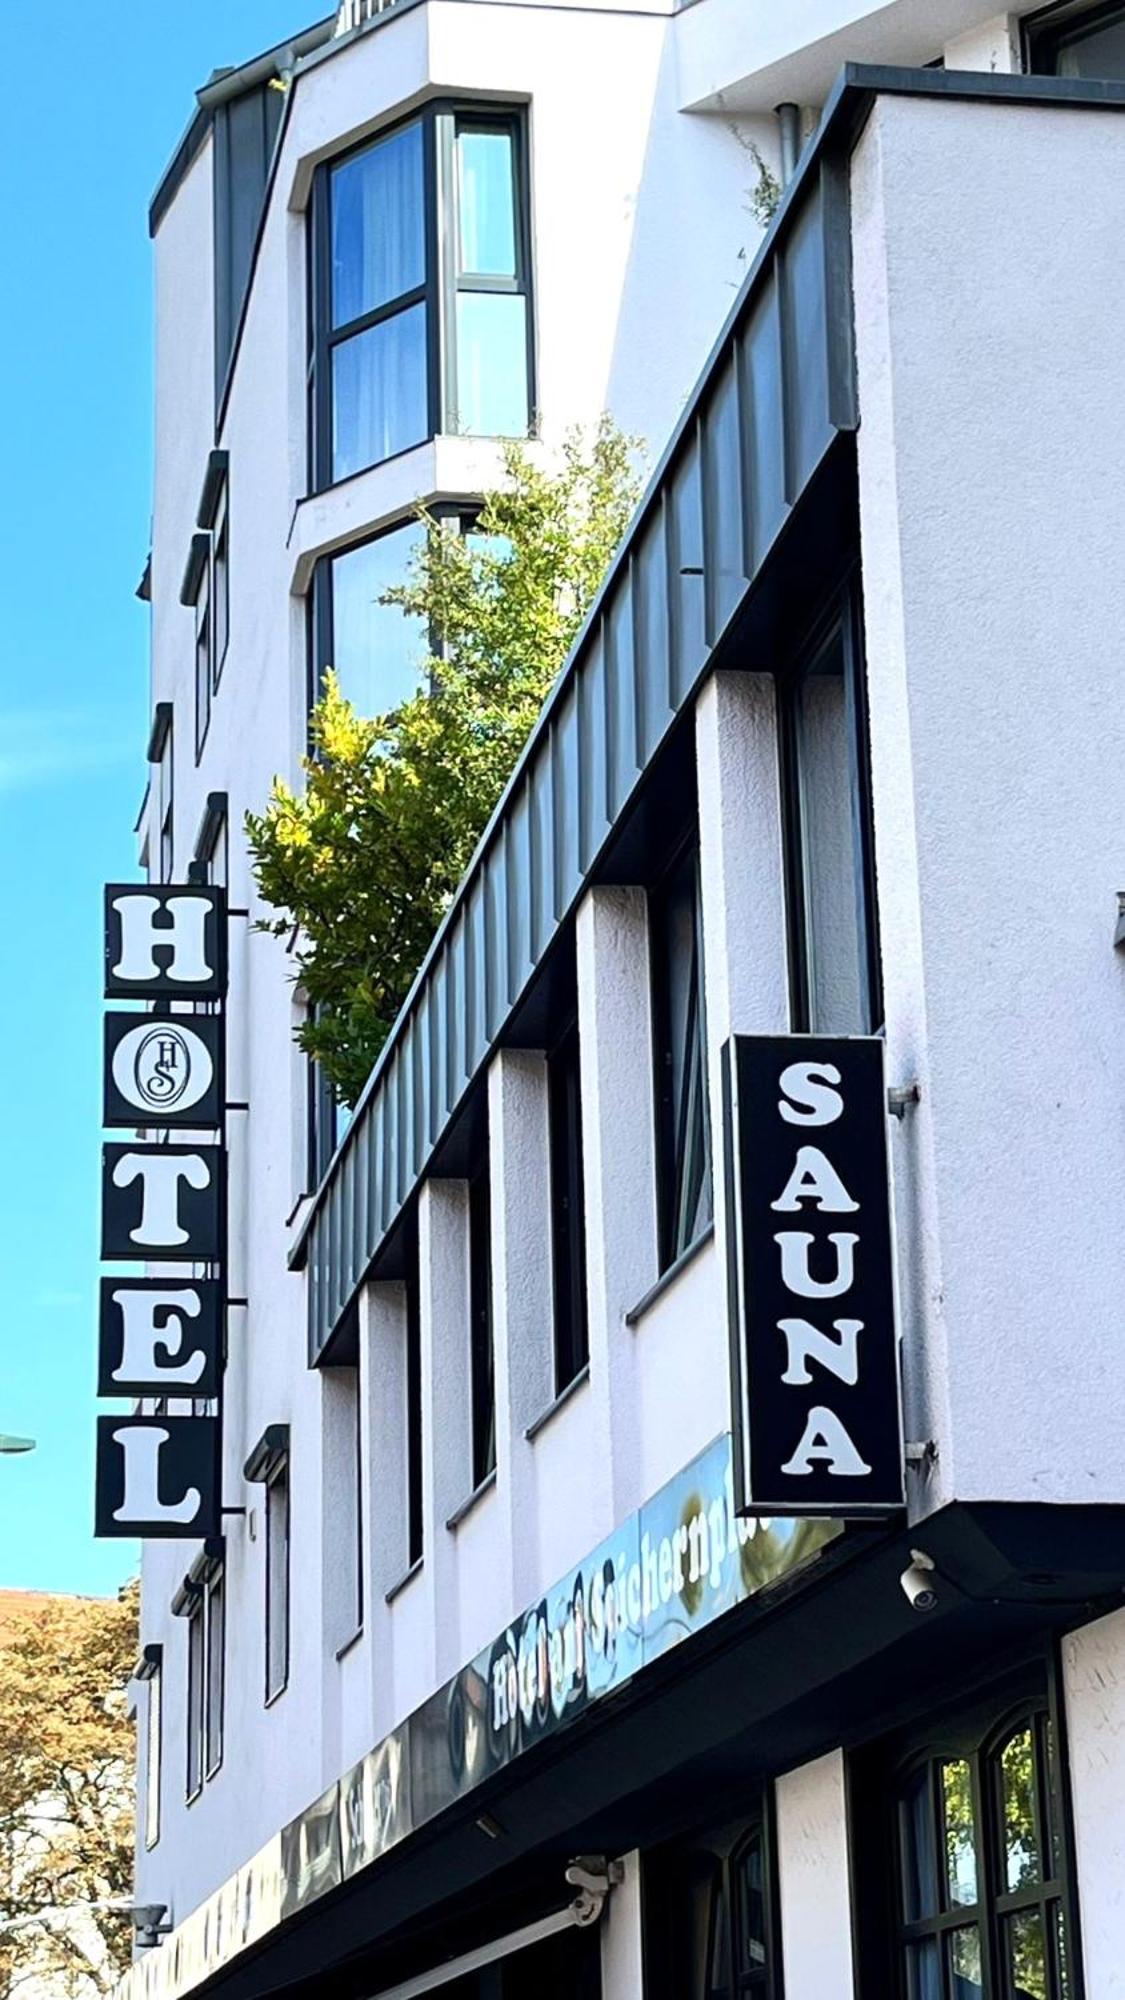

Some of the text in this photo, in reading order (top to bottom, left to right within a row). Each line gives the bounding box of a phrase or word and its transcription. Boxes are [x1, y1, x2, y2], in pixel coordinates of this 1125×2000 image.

[111, 894, 214, 1524] HOTEL
[770, 1061, 872, 1476] SAUNA
[589, 1462, 772, 1664] Spichernpl
